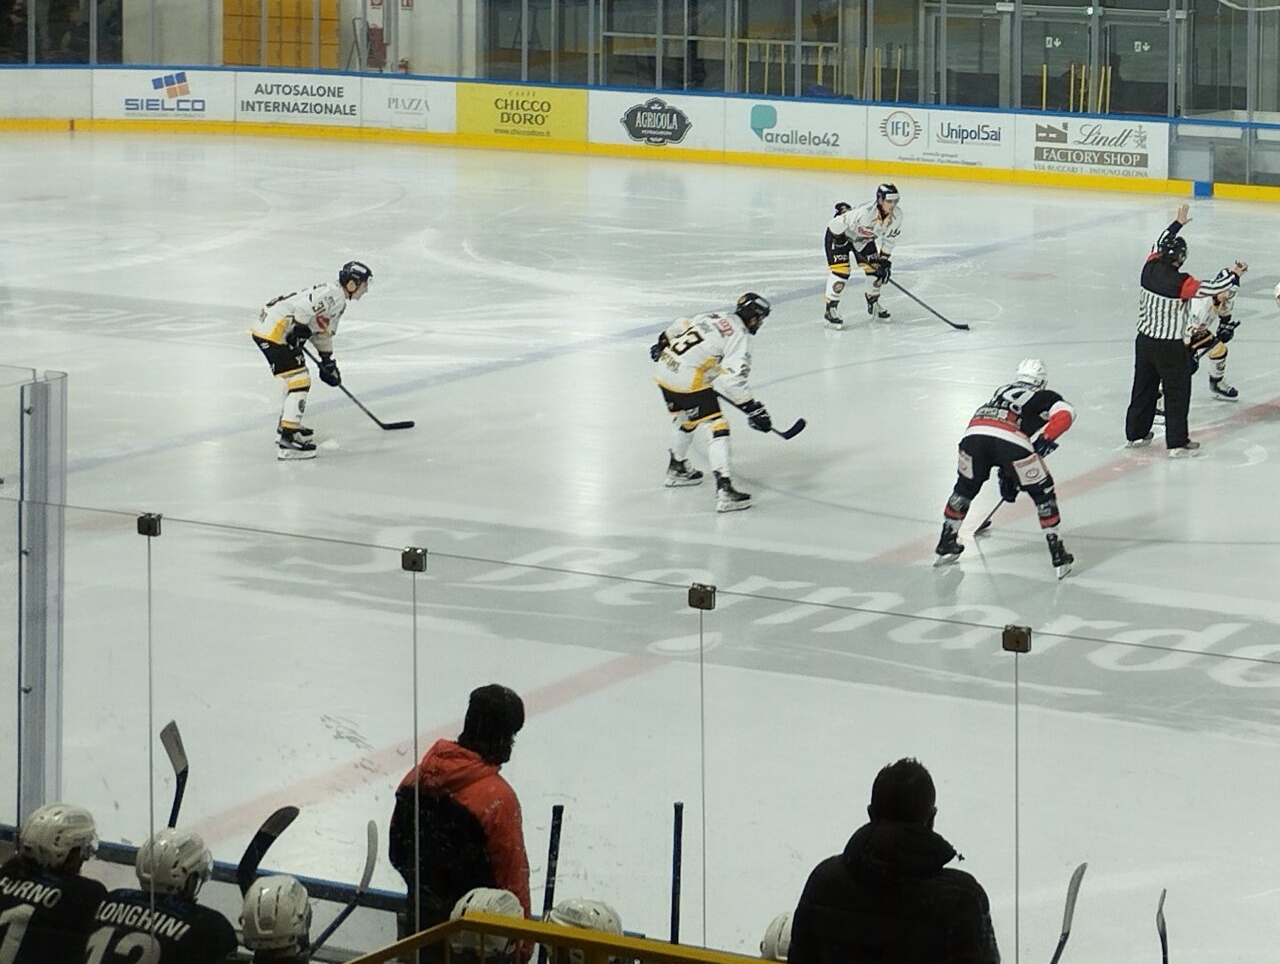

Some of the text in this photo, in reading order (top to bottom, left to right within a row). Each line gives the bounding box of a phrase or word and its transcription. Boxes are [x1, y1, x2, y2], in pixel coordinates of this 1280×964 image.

[254, 84, 344, 98] AUTOSALONE
[125, 99, 206, 112] SIELCO
[240, 100, 357, 116] INTERNAZIONALE
[388, 97, 430, 111] PIAZZA
[494, 98, 552, 113] CHICCO
[635, 111, 679, 130] AGRICOLA
[891, 121, 910, 137] IFC
[939, 122, 1002, 145] UnipolSai
[1073, 123, 1133, 149] Lindt
[1042, 149, 1141, 166] FACTORY SHOP
